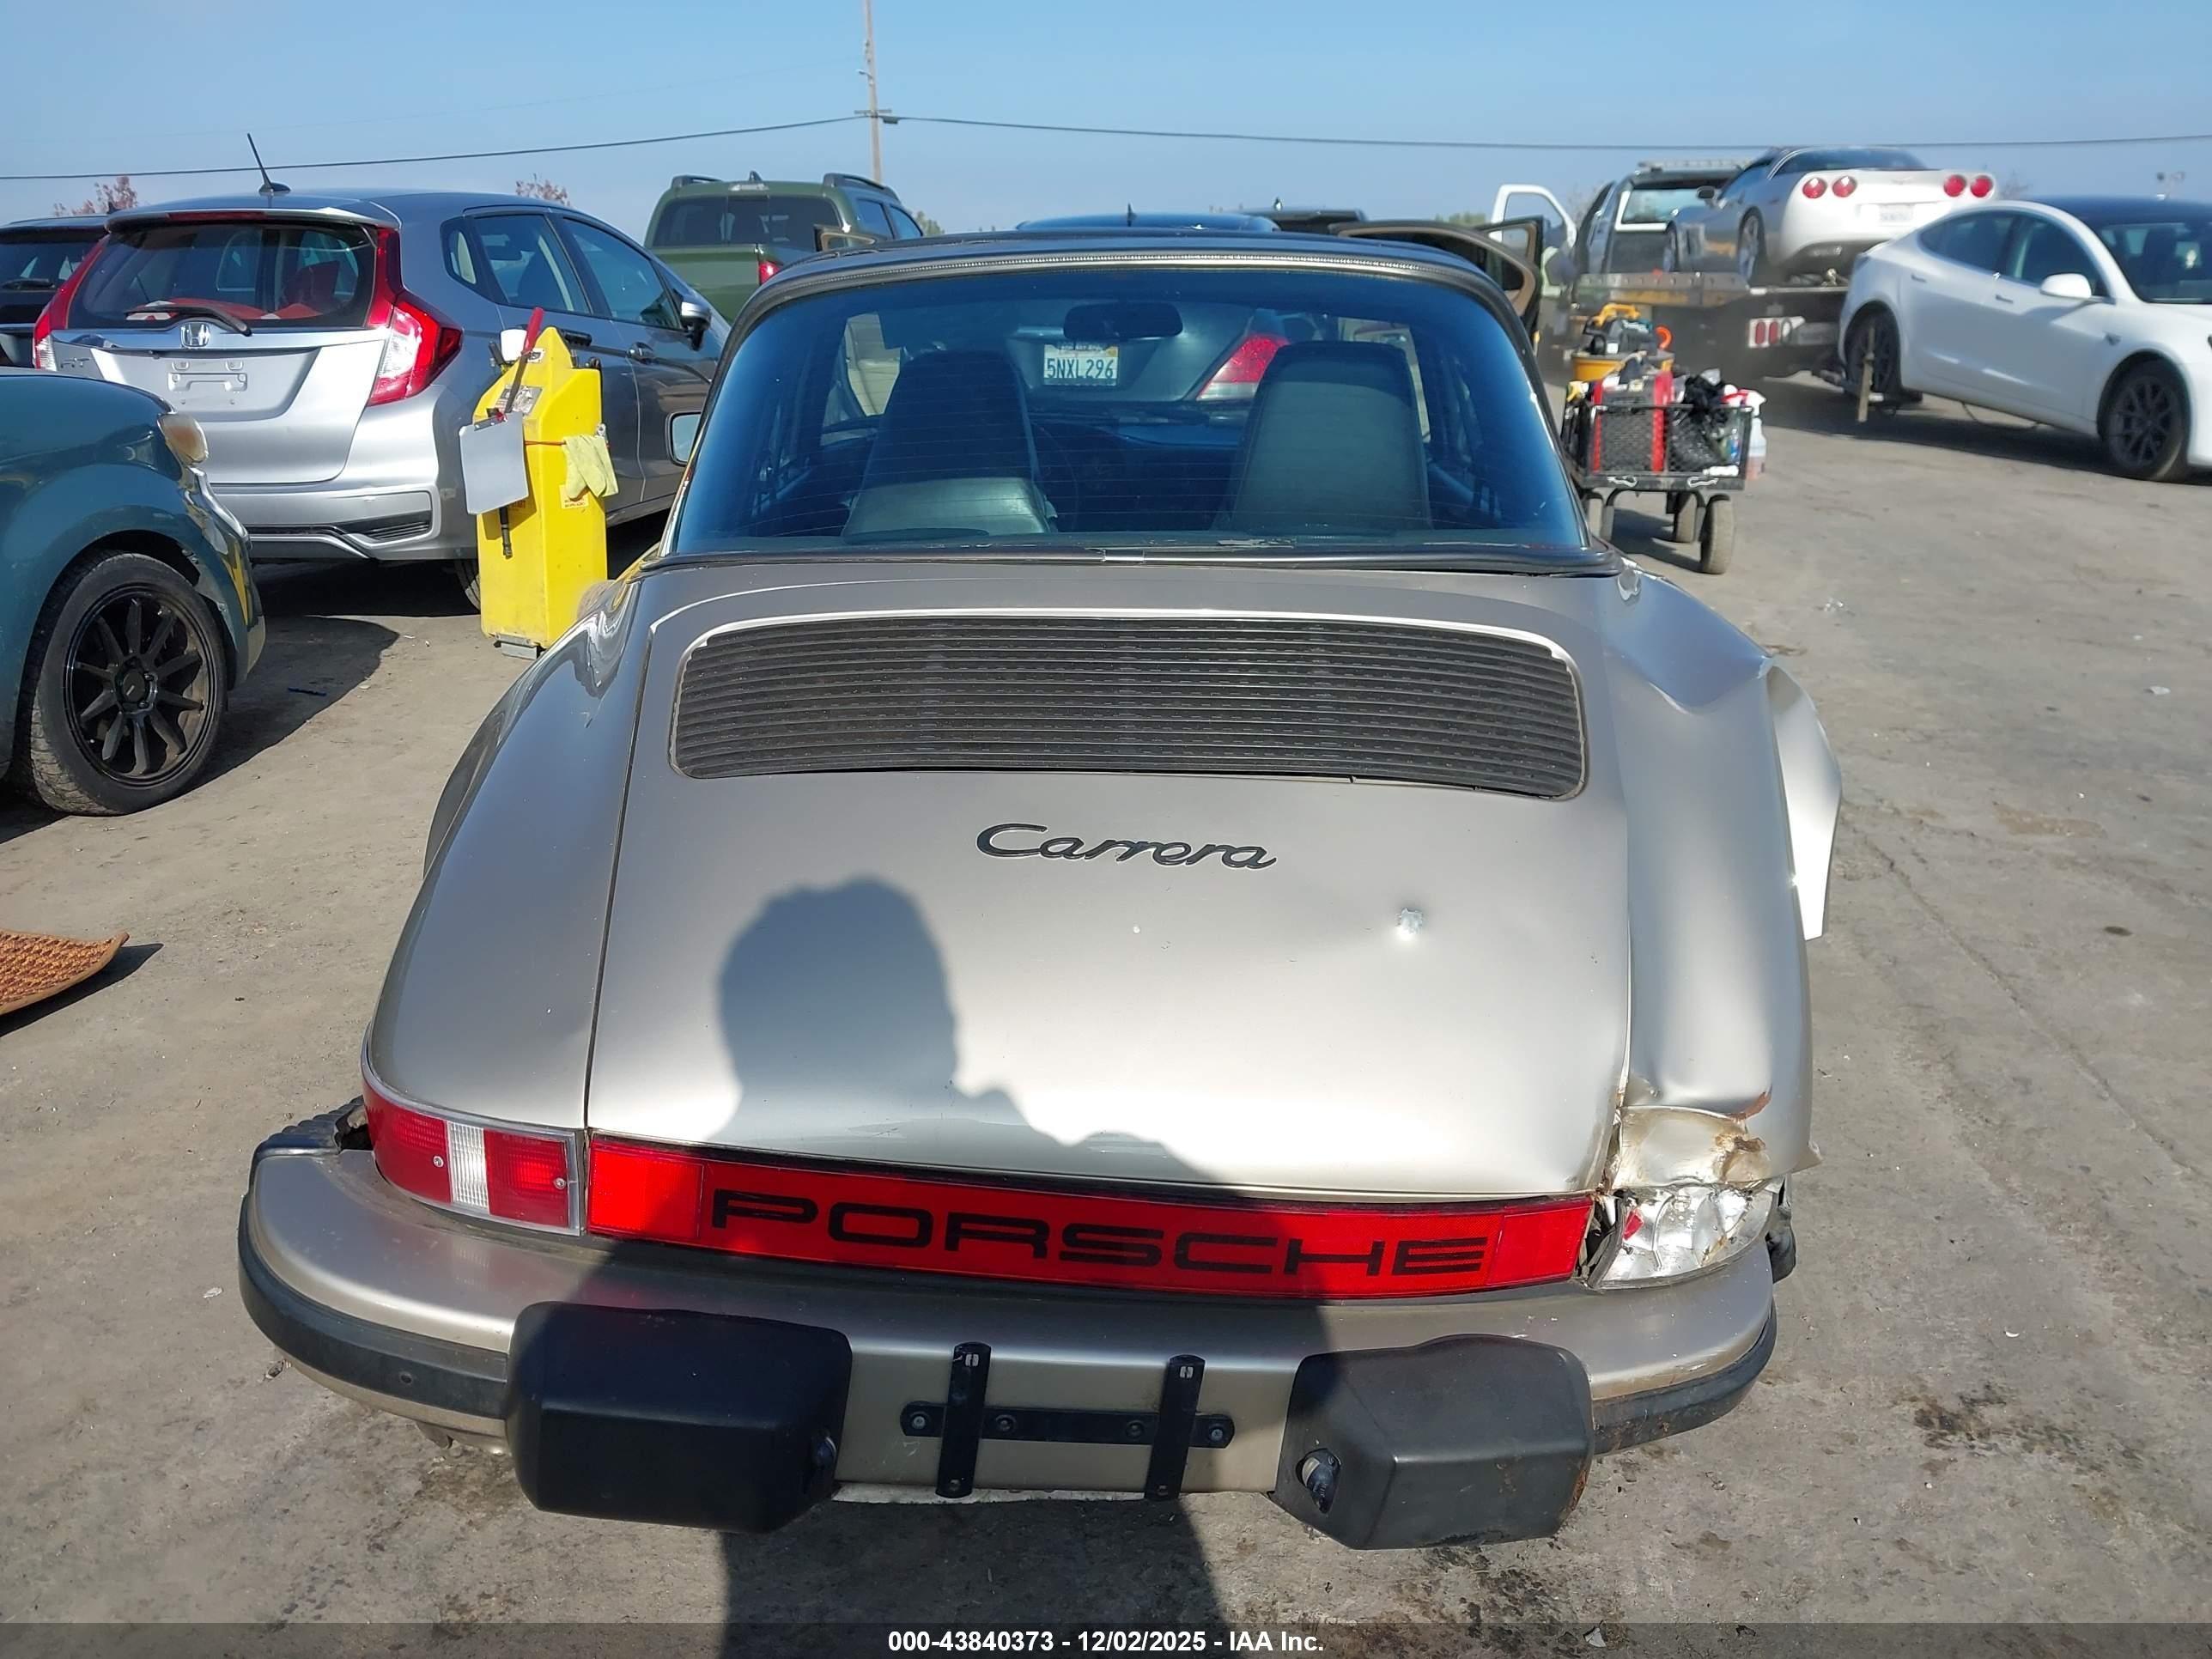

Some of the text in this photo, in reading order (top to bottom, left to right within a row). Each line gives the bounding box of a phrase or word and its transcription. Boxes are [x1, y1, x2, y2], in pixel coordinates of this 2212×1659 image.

[1047, 358, 1115, 379] 5NXL296
[976, 823, 1278, 870] Carrera
[711, 1188, 1488, 1277] PORSCHE
